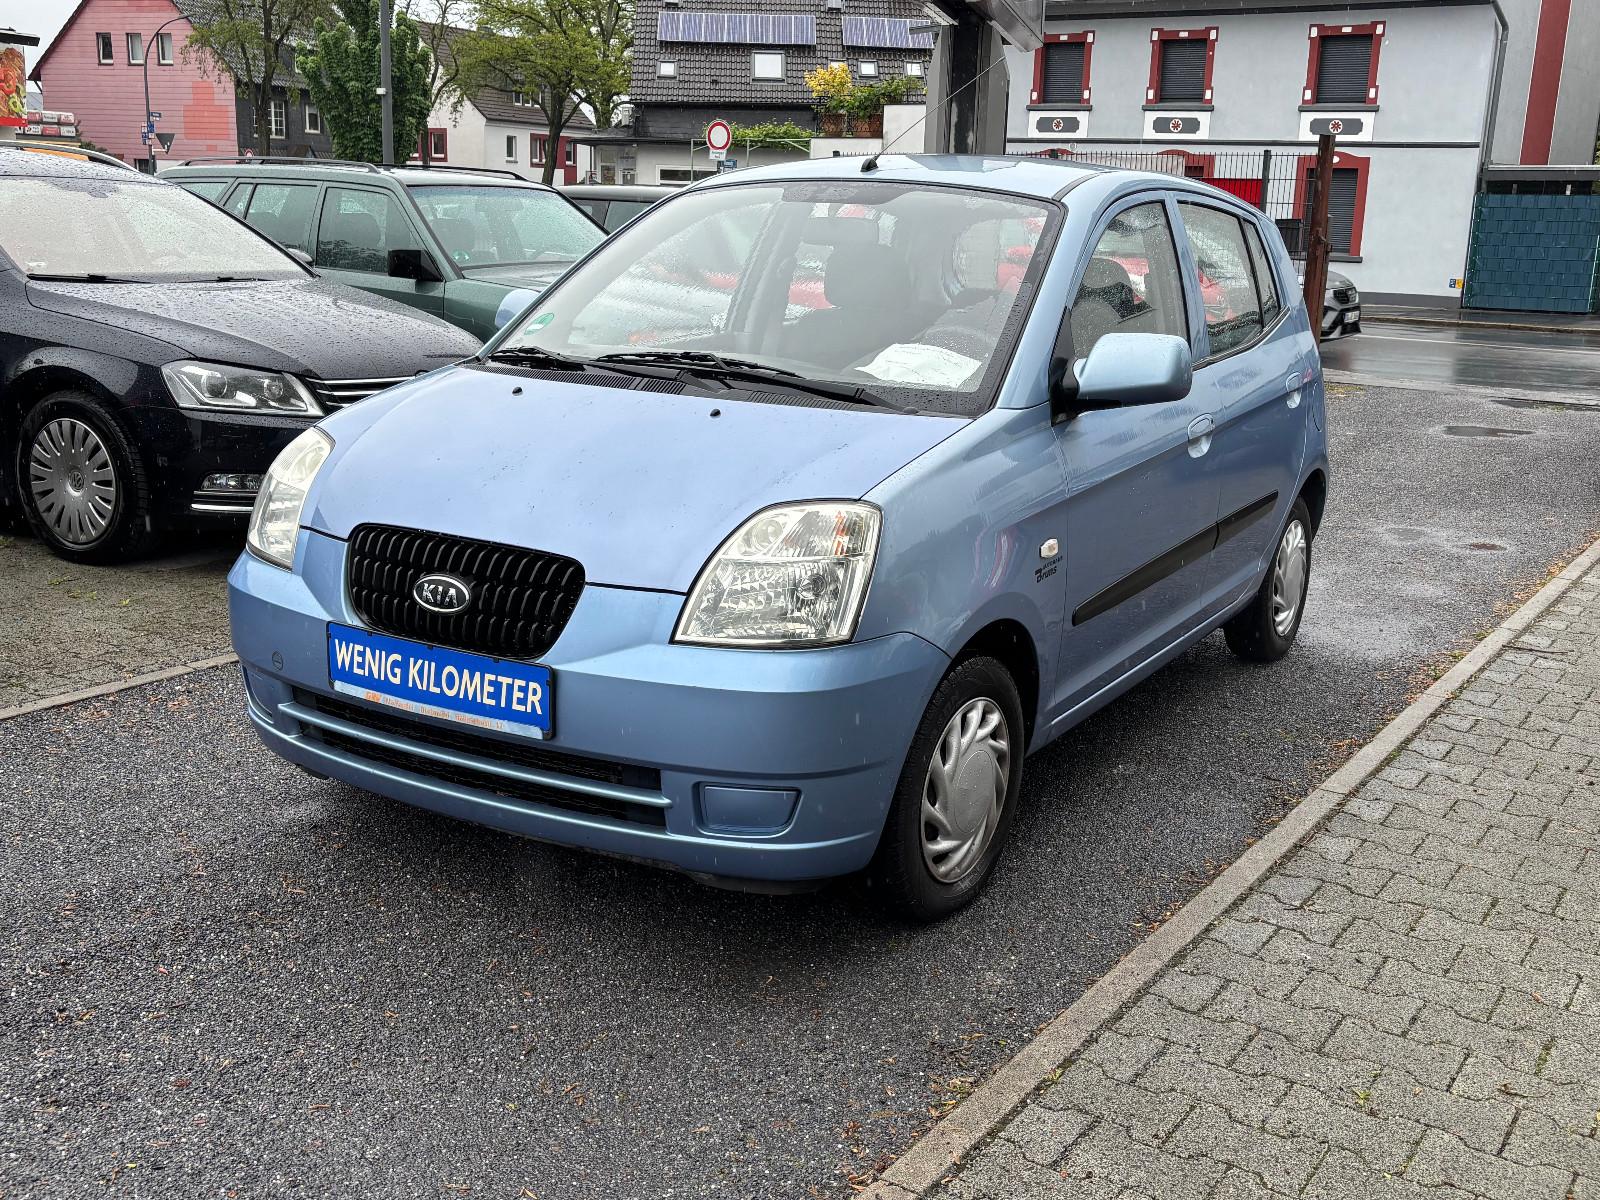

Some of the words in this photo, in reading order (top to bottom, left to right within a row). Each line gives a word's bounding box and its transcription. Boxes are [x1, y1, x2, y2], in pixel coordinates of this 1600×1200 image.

[422, 583, 457, 607] KIA
[334, 638, 402, 685] WENIG
[408, 657, 542, 715] KILOMETER
